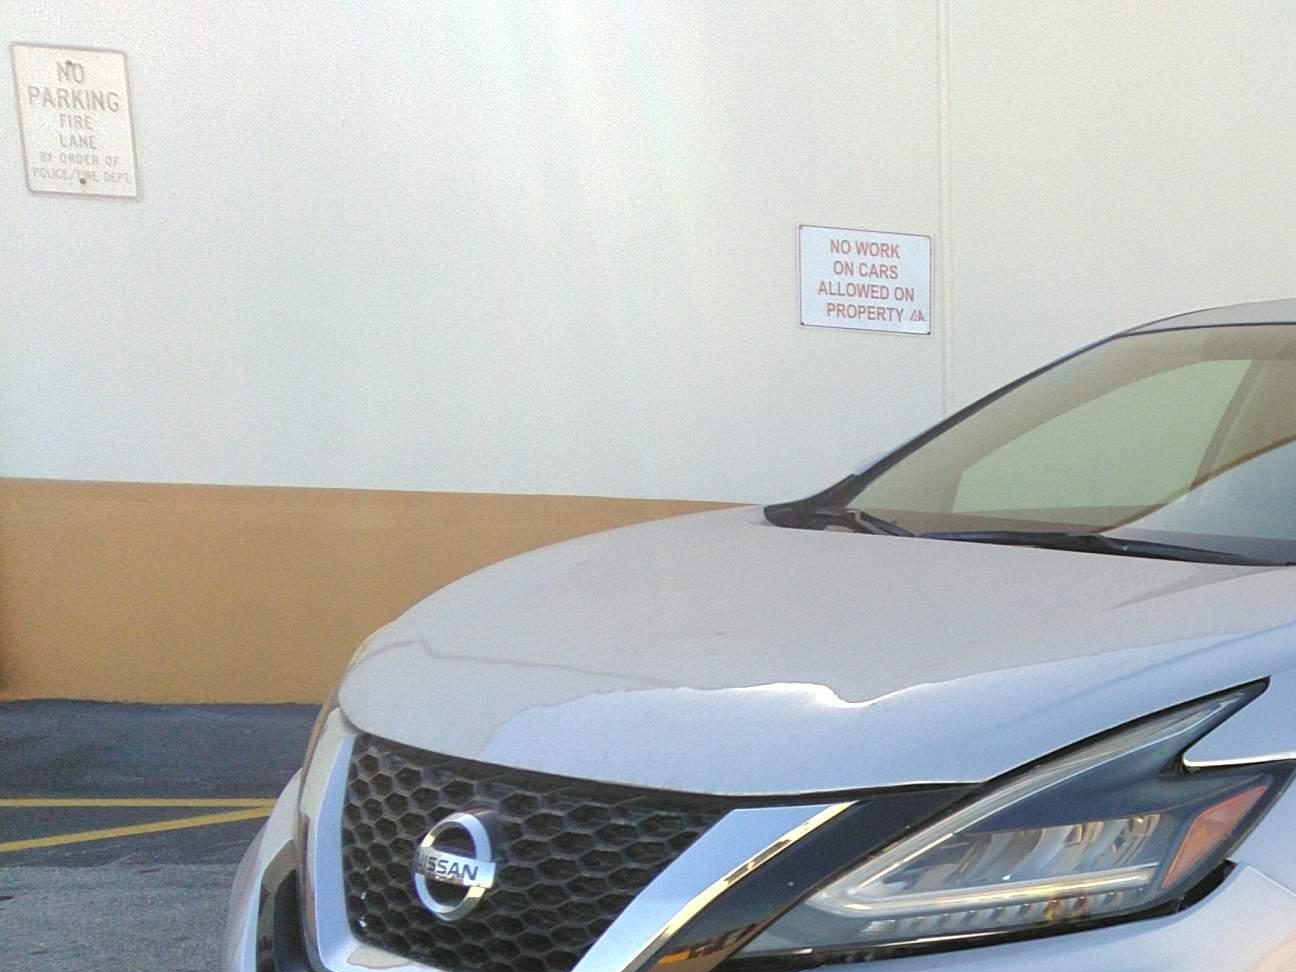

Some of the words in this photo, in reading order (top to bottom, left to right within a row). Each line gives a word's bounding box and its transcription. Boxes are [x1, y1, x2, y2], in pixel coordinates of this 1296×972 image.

[56, 61, 84, 84] NO
[27, 86, 119, 112] PARKING
[59, 114, 93, 129] FIRE
[59, 134, 97, 149] LANE
[60, 152, 98, 165] ORDER
[105, 156, 120, 167] OF
[830, 239, 851, 254] NO
[855, 241, 900, 258] WORK
[833, 261, 854, 276] ON
[859, 262, 898, 279] CARS
[818, 281, 889, 300] ALLOWED
[894, 287, 914, 302] ON
[827, 303, 904, 322] PROPERTY
